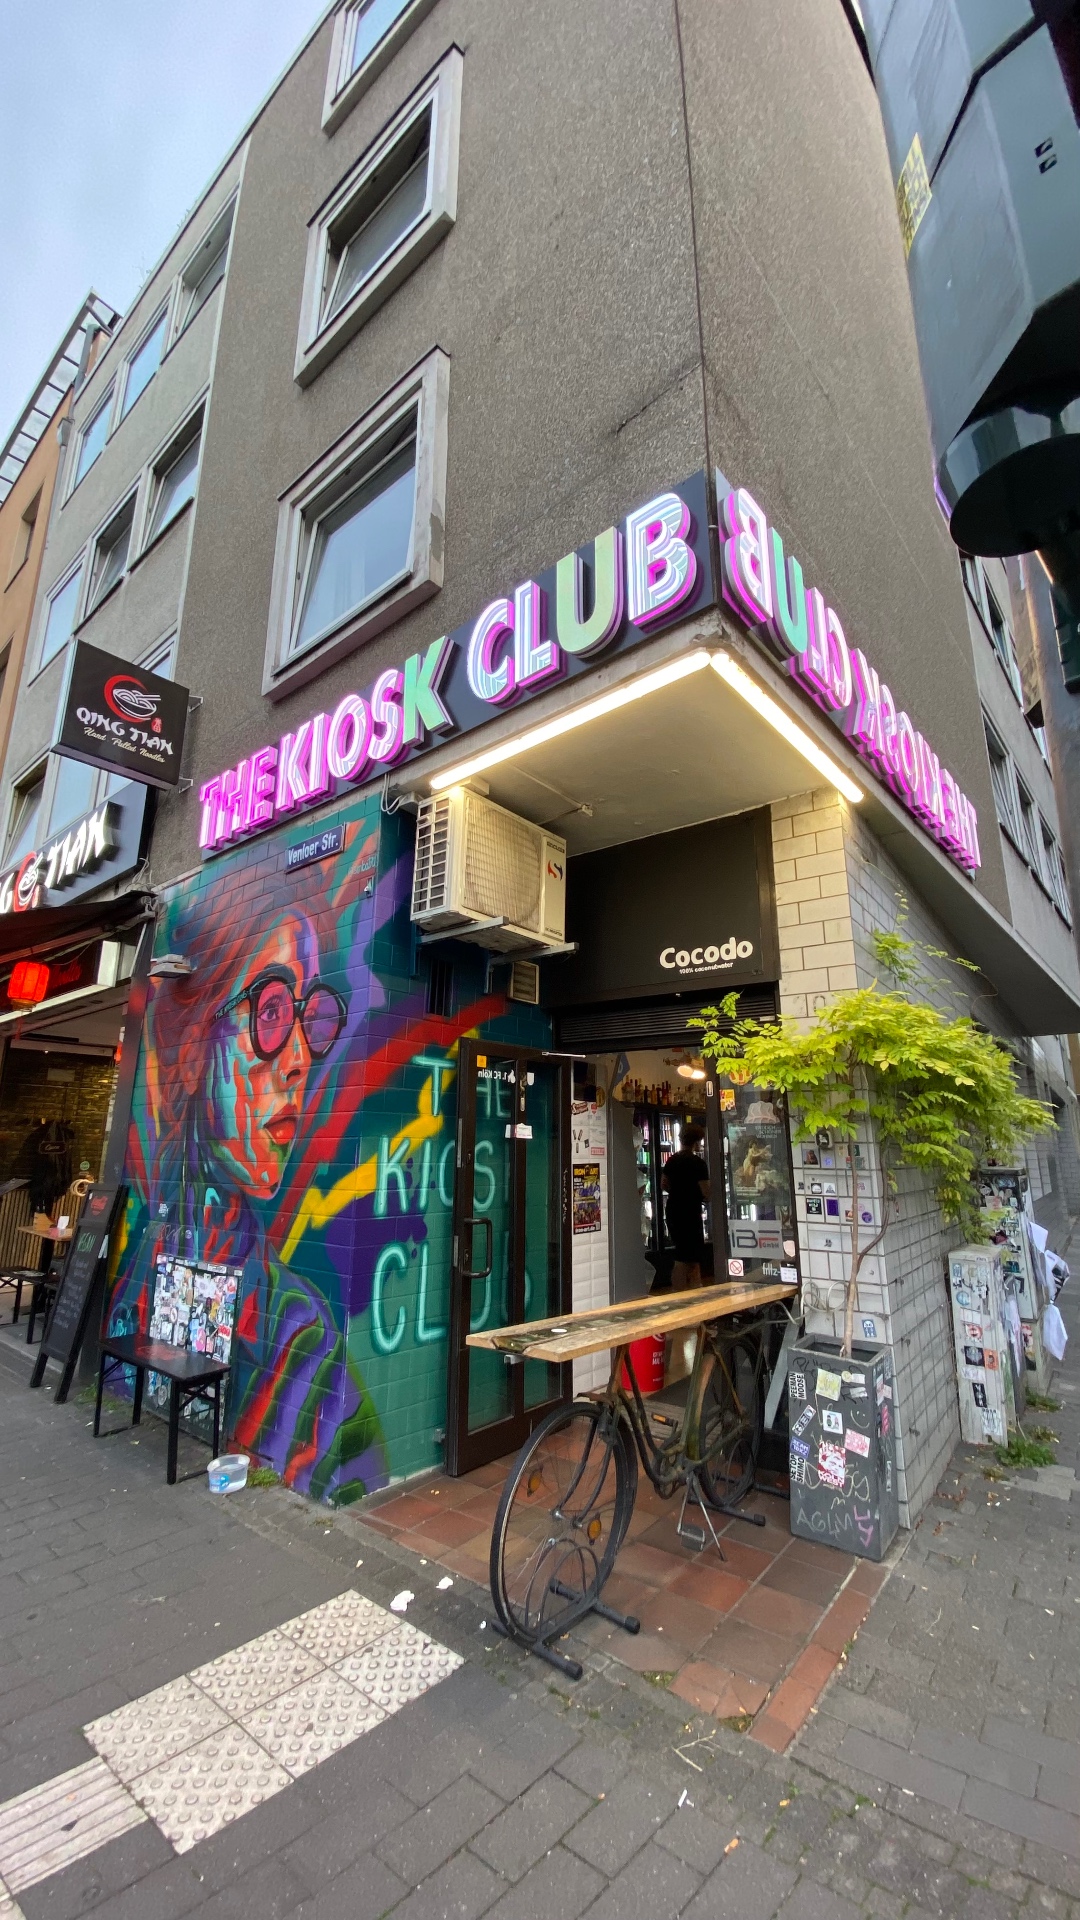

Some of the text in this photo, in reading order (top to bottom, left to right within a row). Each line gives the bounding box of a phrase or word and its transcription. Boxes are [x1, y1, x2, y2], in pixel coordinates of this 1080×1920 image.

[199, 492, 698, 851] THE KIOSK CLUB
[76, 707, 125, 736] QING
[129, 727, 174, 755] TIAN
[83, 726, 166, 763] Hand Pulled Noodles
[45, 801, 114, 889] TIAN
[288, 832, 339, 865] Venloer Str.
[660, 936, 753, 968] Cocodo
[679, 967, 693, 975] 100%
[797, 1374, 806, 1398] MOOSE
